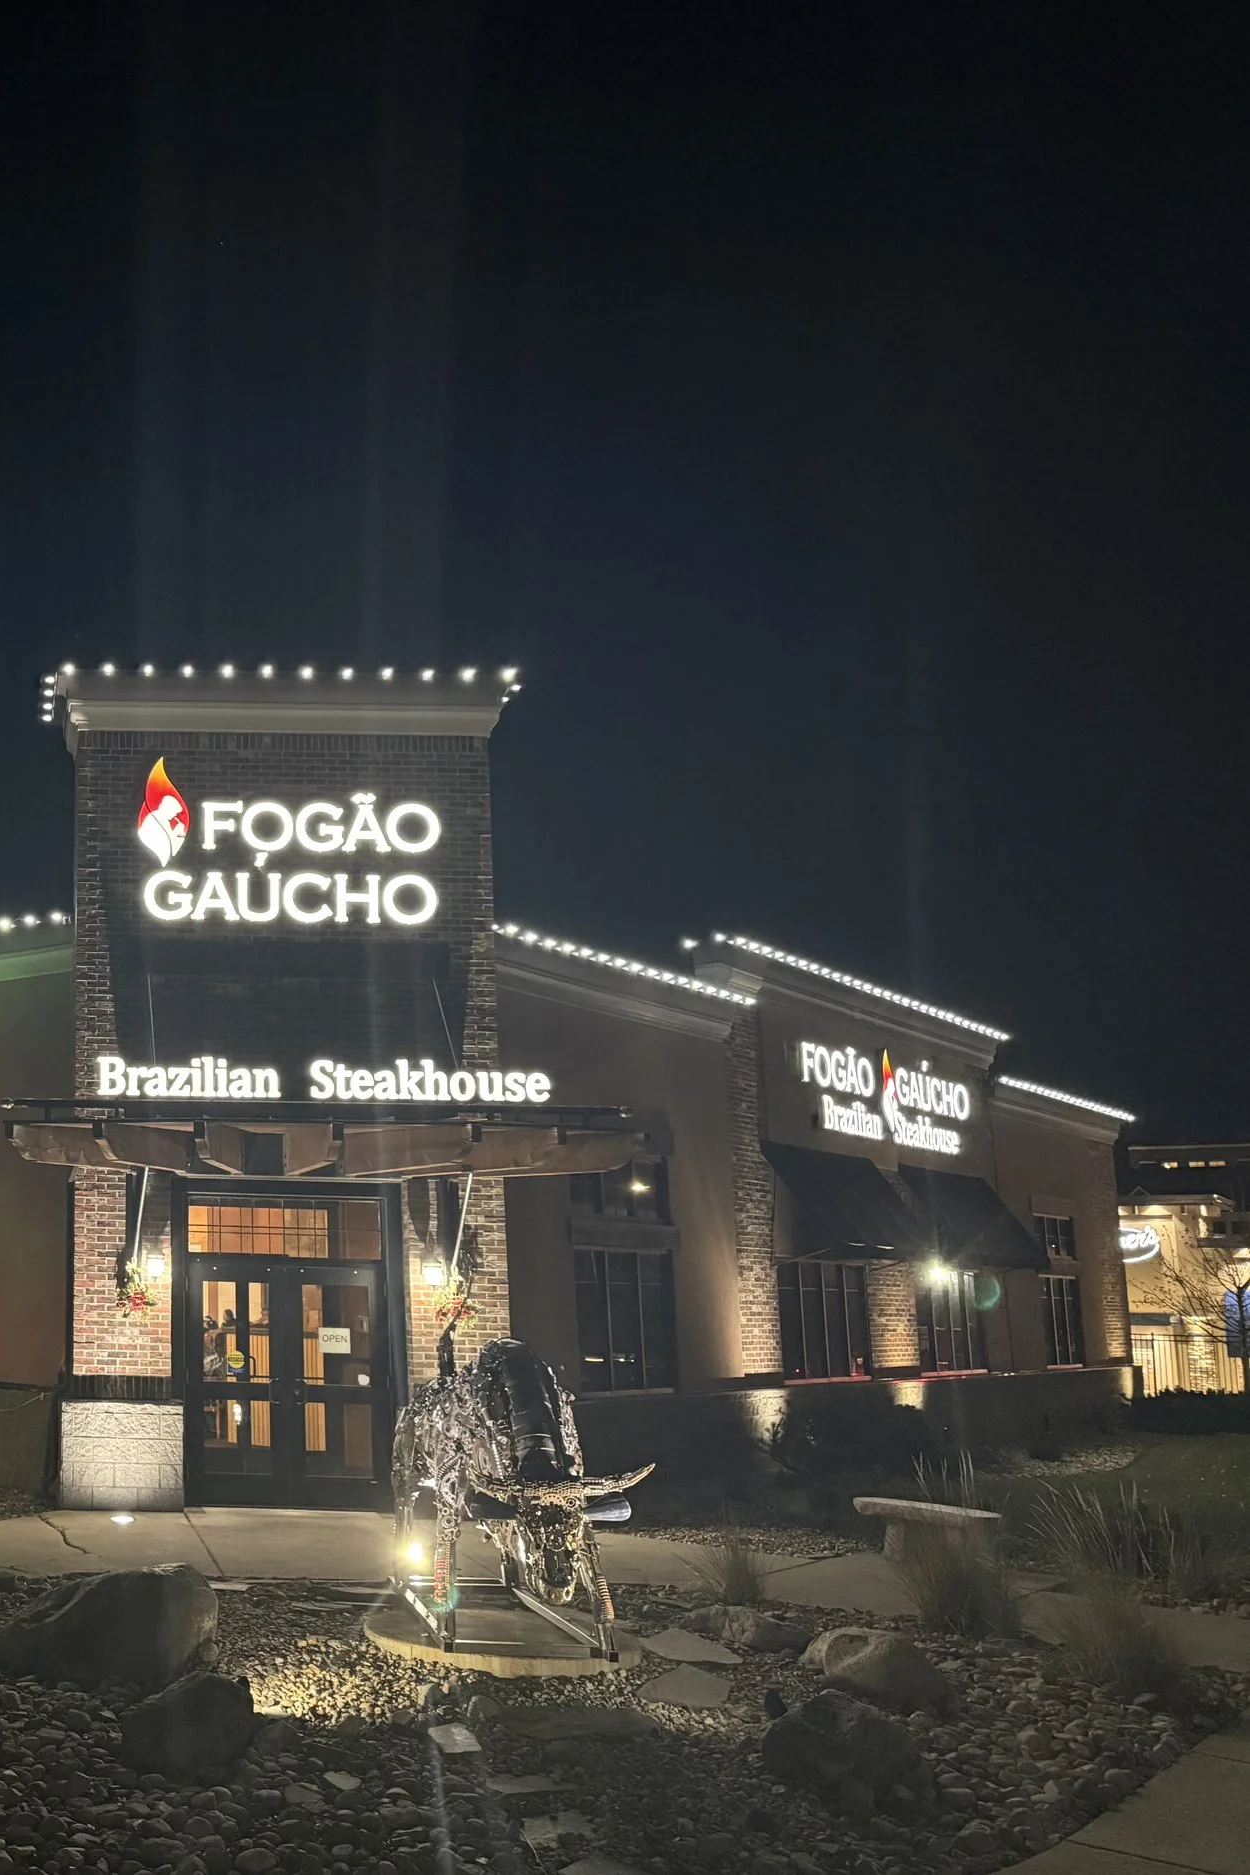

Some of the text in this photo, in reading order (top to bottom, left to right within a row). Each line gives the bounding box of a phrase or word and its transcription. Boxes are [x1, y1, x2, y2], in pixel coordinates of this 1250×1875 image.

[200, 791, 443, 855] FOGÃO
[142, 851, 440, 927] GAÚCHO
[96, 1055, 552, 1103] Brazilian Steakhouse
[800, 1041, 876, 1098] FOGÃO
[822, 1093, 961, 1156] Brazilian Steakhouse
[321, 1333, 349, 1343] OPEN
